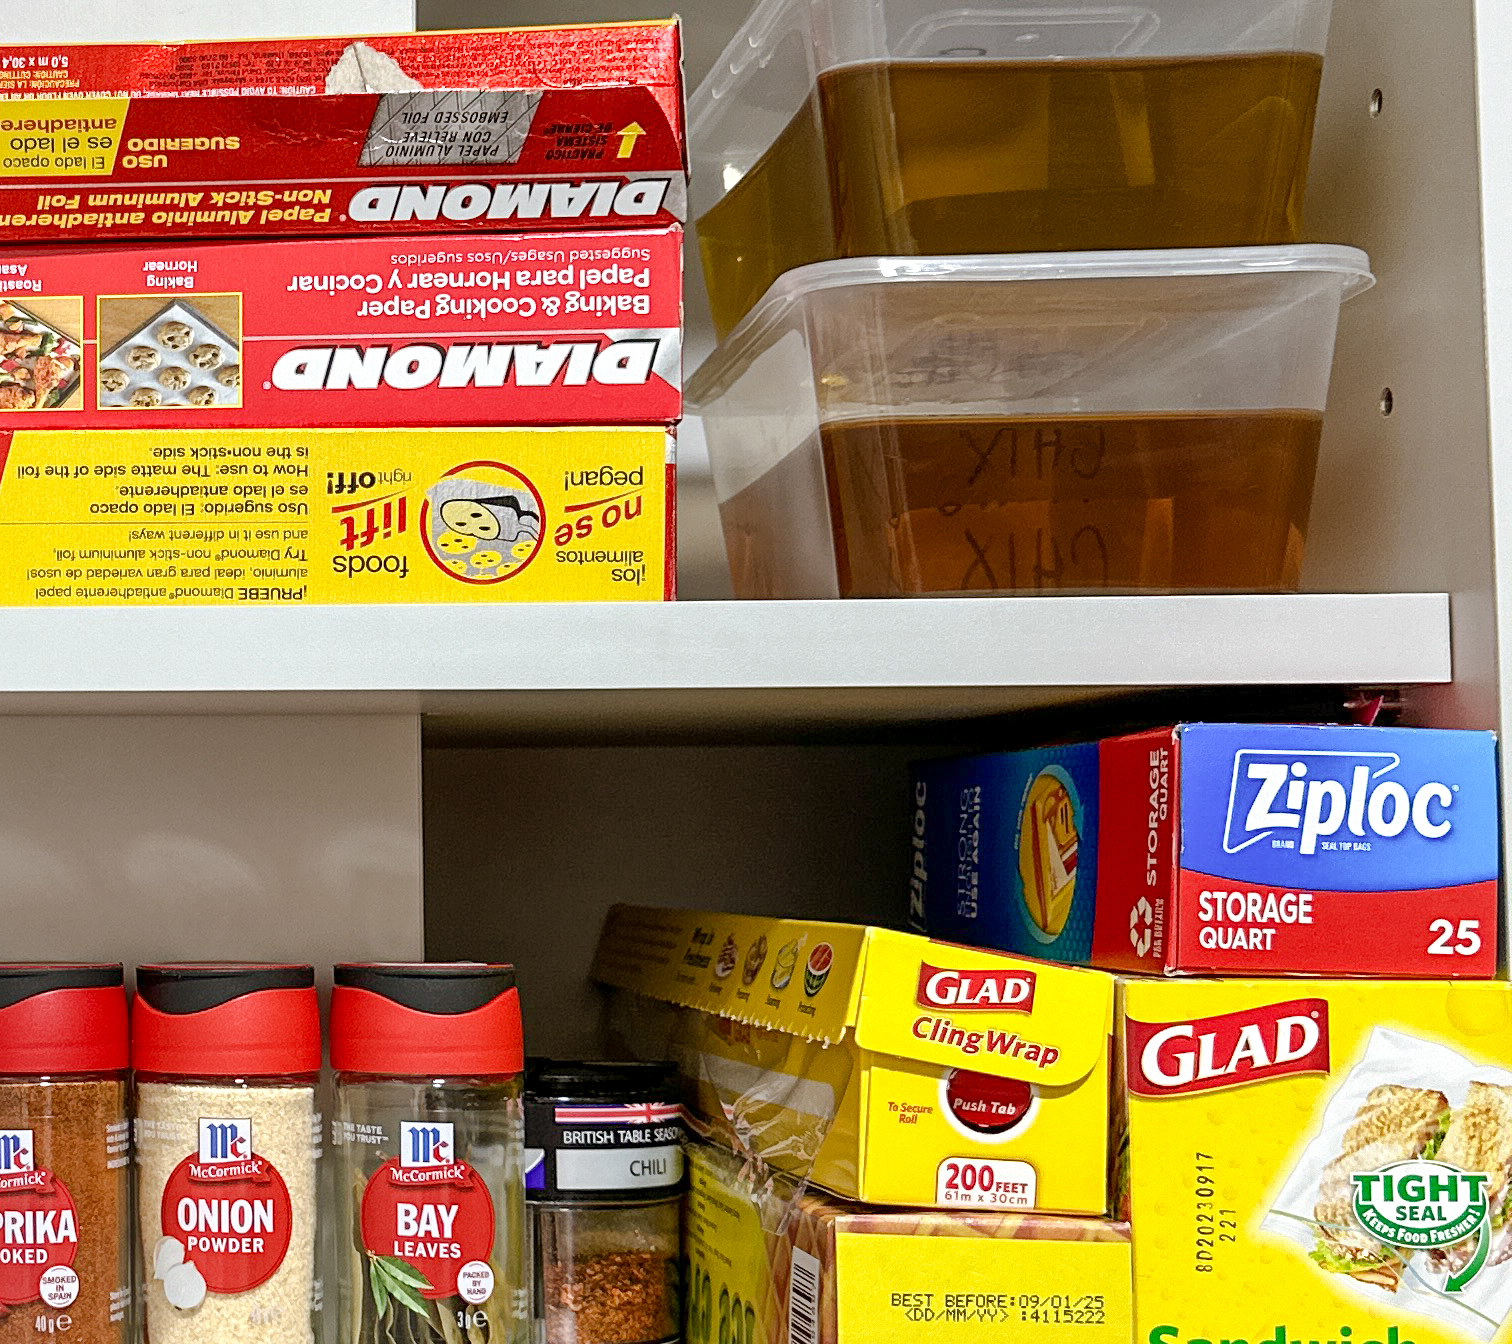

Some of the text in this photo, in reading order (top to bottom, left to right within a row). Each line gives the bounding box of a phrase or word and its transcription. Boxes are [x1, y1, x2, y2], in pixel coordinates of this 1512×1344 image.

[401, 111, 508, 125] EMBOSSED FOIL
[128, 137, 241, 150] SUGERIDO
[401, 131, 491, 143] CON RELIEVE
[122, 154, 168, 168] USO
[386, 144, 499, 158] PAPEL ALUMINIO
[38, 187, 331, 209] Non-Stick Aluminum Foil
[348, 179, 671, 221] DIAMOND
[153, 210, 254, 227] Aluminio
[262, 204, 332, 224] Papel
[143, 260, 198, 273] Hornear
[146, 274, 194, 288] Baking
[287, 264, 650, 295] Papel para Hornear y Cocinar
[356, 291, 650, 320] Baking & Cooking Paper
[271, 338, 661, 391] DIAMOND
[327, 468, 412, 494] right off!
[564, 467, 643, 490] pegan!
[340, 497, 407, 551] lift
[554, 495, 642, 546] no se
[332, 556, 409, 578] foods
[556, 550, 643, 565] alimentos
[1160, 748, 1169, 820] QUART
[1146, 750, 1160, 886] STORAGE
[1246, 762, 1454, 855] Ziploc
[1199, 891, 1313, 924] STORAGE
[1200, 927, 1276, 951] QUART
[1427, 919, 1482, 955] 25
[926, 971, 1029, 1005] GLAD
[912, 1017, 1059, 1067] Cling Wrap
[1141, 1015, 1319, 1087] GLAD
[953, 1098, 1016, 1115] Push Tab
[563, 1129, 651, 1144] BRITISH TABLE
[189, 1162, 260, 1178] McCormick
[390, 1165, 463, 1182] McCormick
[630, 1159, 666, 1176] CHILI
[945, 1163, 1028, 1194] 200 FEET
[945, 1191, 1027, 1204] 61m x 30cm
[1352, 1174, 1487, 1202] TIGHT
[177, 1197, 274, 1233] ONION
[396, 1203, 459, 1237] BAY
[1396, 1206, 1447, 1221] SEAL
[1218, 1208, 1237, 1242] 221
[1362, 1208, 1479, 1244] KEEPS FOOD FRESHER!
[188, 1235, 264, 1253] POWDER
[394, 1242, 461, 1258] LEAVES
[42, 1275, 76, 1285] SMOKED
[56, 1284, 65, 1292] IN
[48, 1292, 72, 1302] SPAIN
[892, 1294, 1104, 1309] BEST BEFORE:09/01/25
